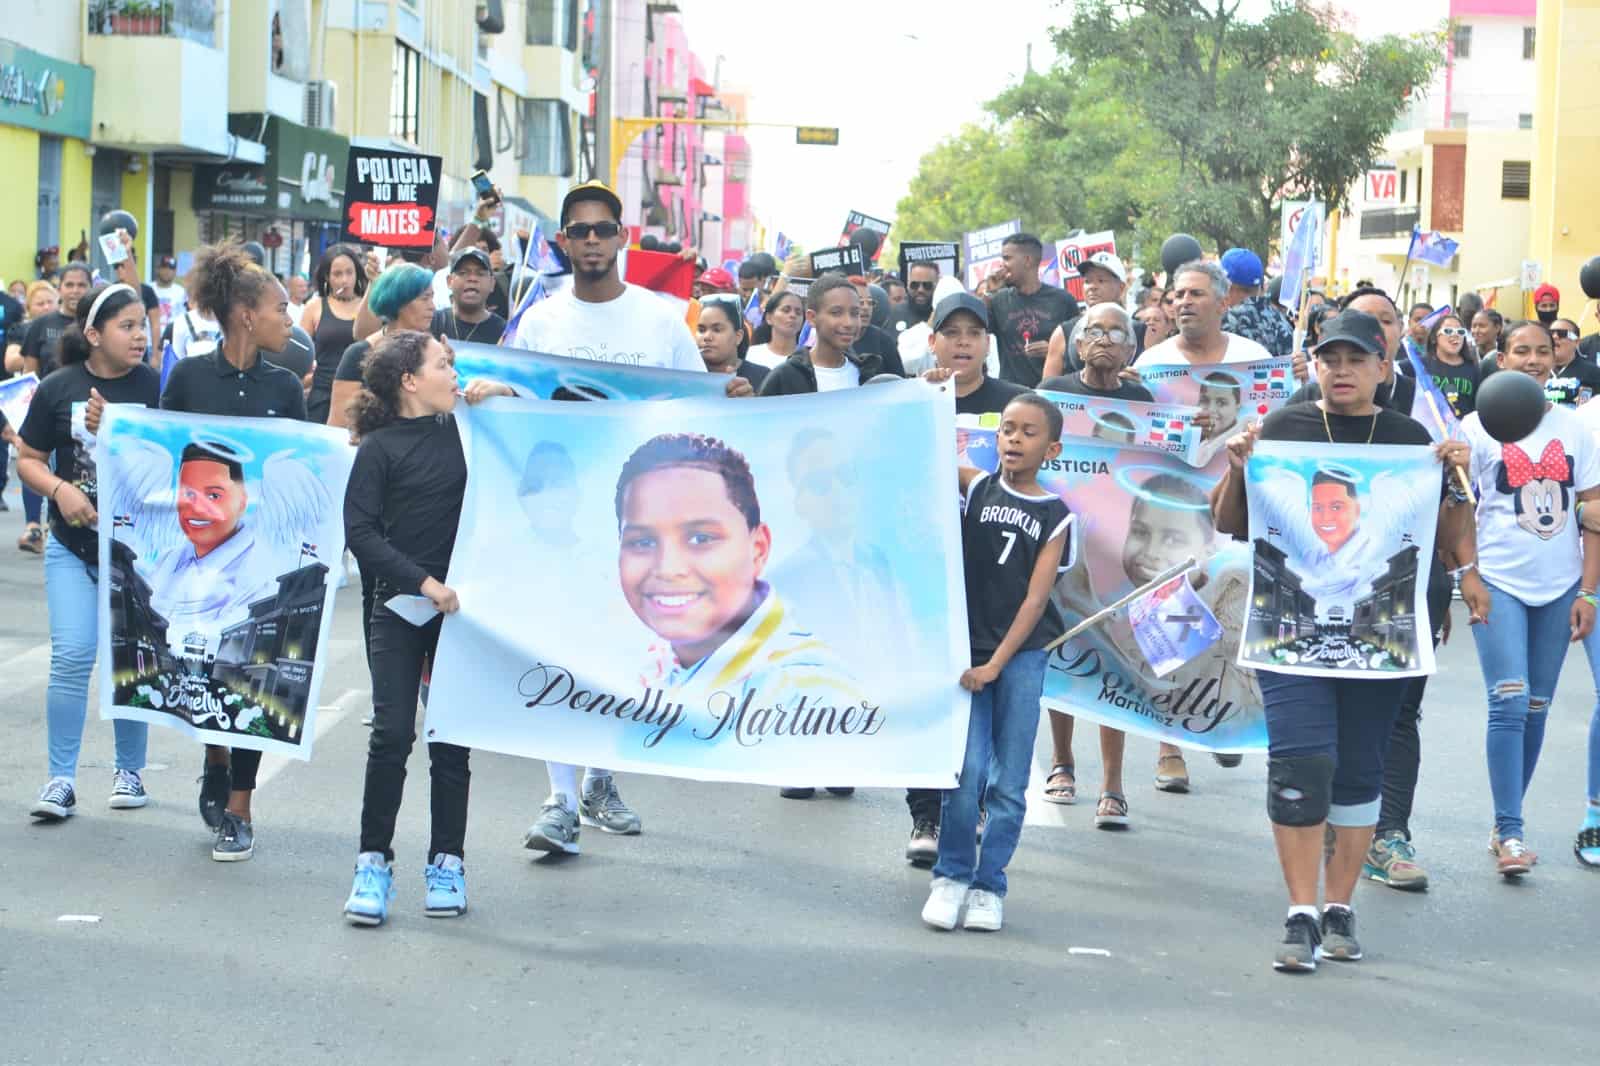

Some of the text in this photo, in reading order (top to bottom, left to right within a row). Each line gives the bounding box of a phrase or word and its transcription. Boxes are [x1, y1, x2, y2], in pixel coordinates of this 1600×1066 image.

[356, 157, 433, 184] POLICIA
[373, 183, 417, 201] NO ME
[1371, 173, 1396, 198] YA
[361, 208, 420, 235] MATES
[980, 505, 1041, 541] BROOKLIN
[998, 531, 1017, 565] 7
[517, 662, 687, 748] Donelly
